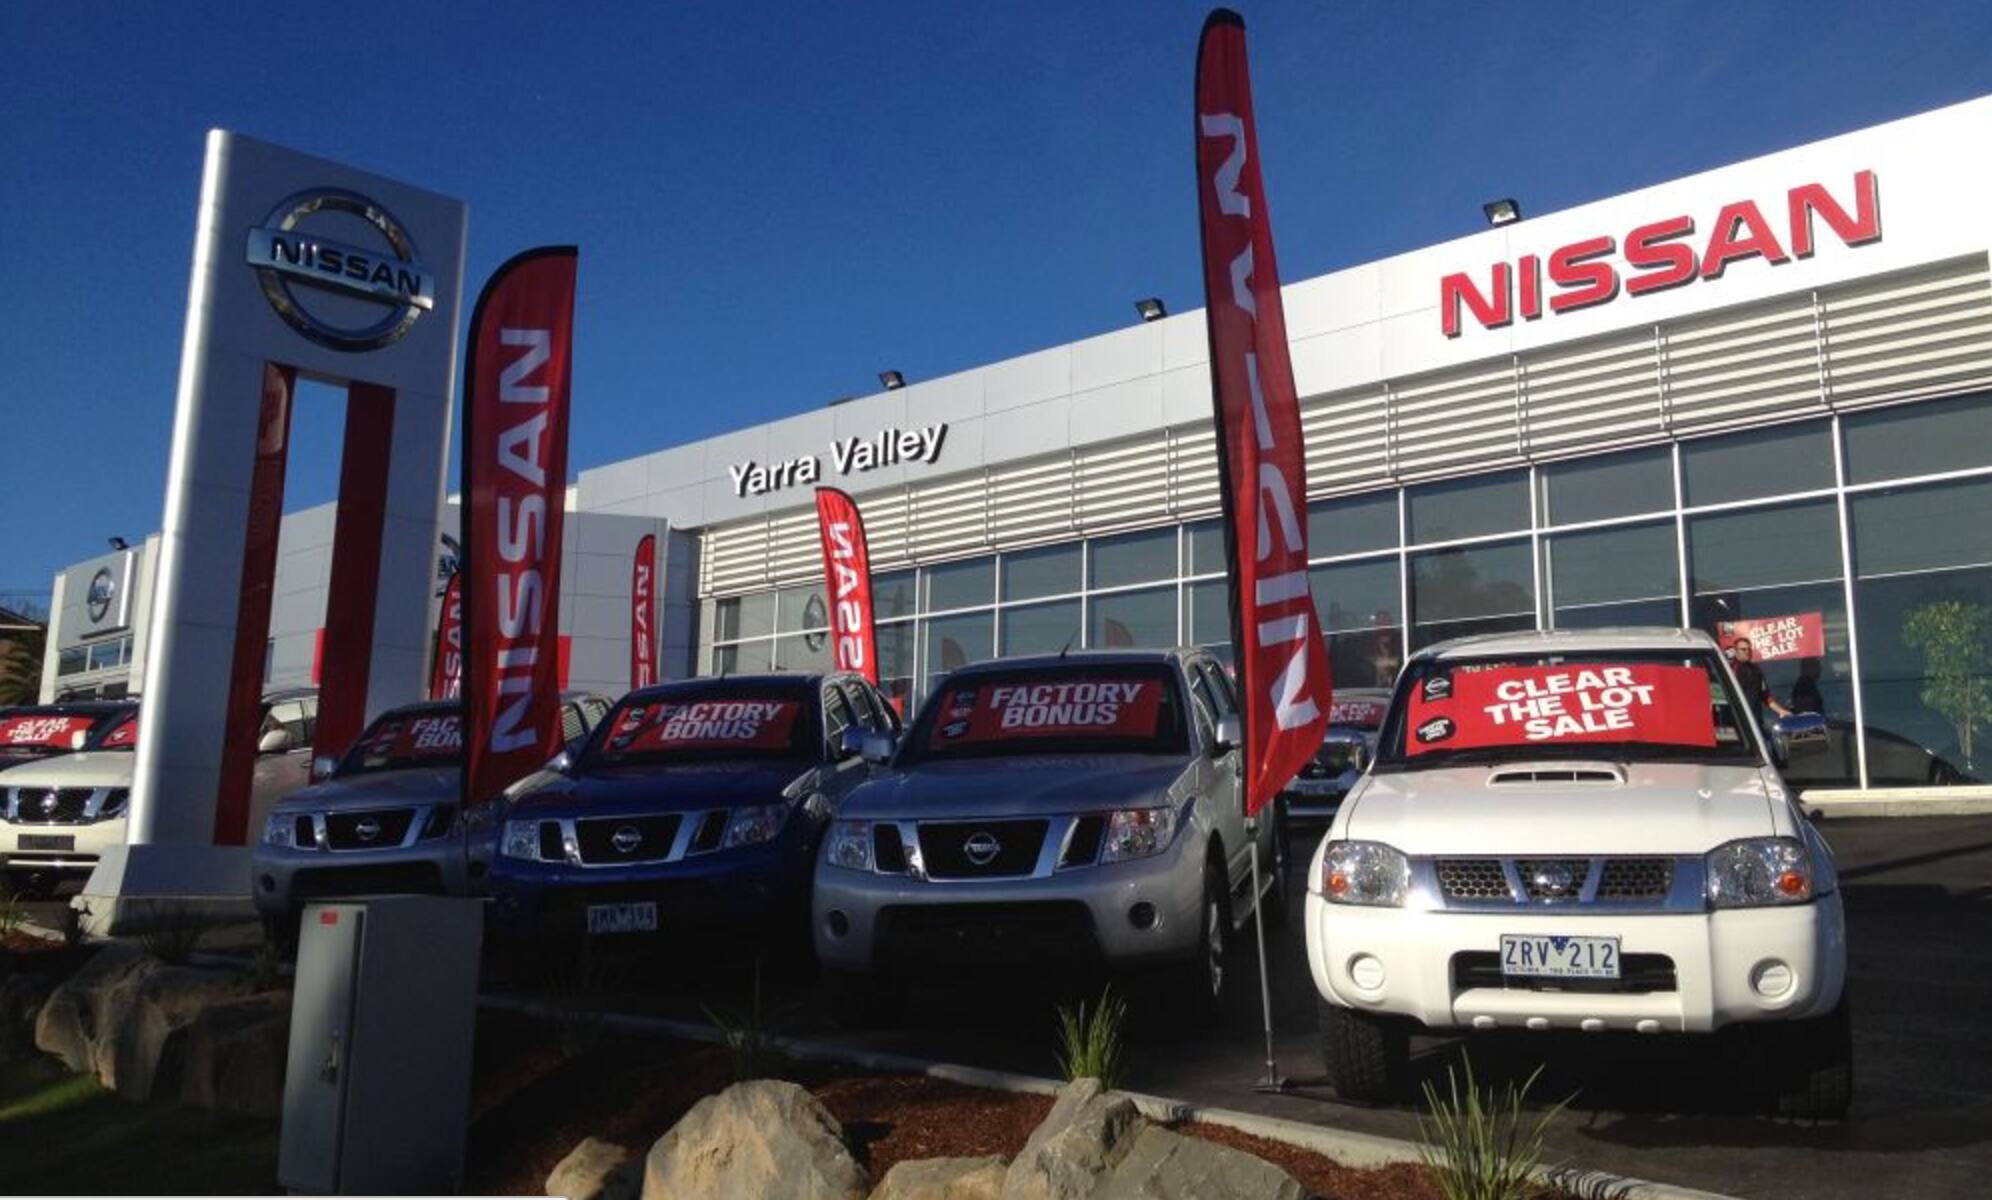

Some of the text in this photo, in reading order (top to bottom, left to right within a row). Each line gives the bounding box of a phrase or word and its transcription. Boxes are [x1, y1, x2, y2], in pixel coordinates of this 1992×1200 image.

[270, 236, 421, 296] NISSAN
[1441, 169, 1882, 338] NISSAN
[1202, 113, 1320, 731] NISAN
[730, 423, 948, 497] Yarra Valley
[491, 328, 551, 753] NISSAN
[636, 565, 650, 689] SSAN
[1751, 617, 1797, 639] CLEAR
[1778, 626, 1804, 643] LOT
[1761, 641, 1799, 660] SALE
[990, 683, 1144, 709] FACTORY
[1497, 667, 1635, 701] CLEAR
[655, 703, 783, 723] FACTORY
[1001, 703, 1119, 728] BONUS
[1484, 685, 1655, 725] THE LOT
[660, 711, 760, 740] BONUS
[1525, 707, 1635, 741] SALE
[415, 732, 462, 748] BON
[1505, 940, 1614, 968] ZRV 212
